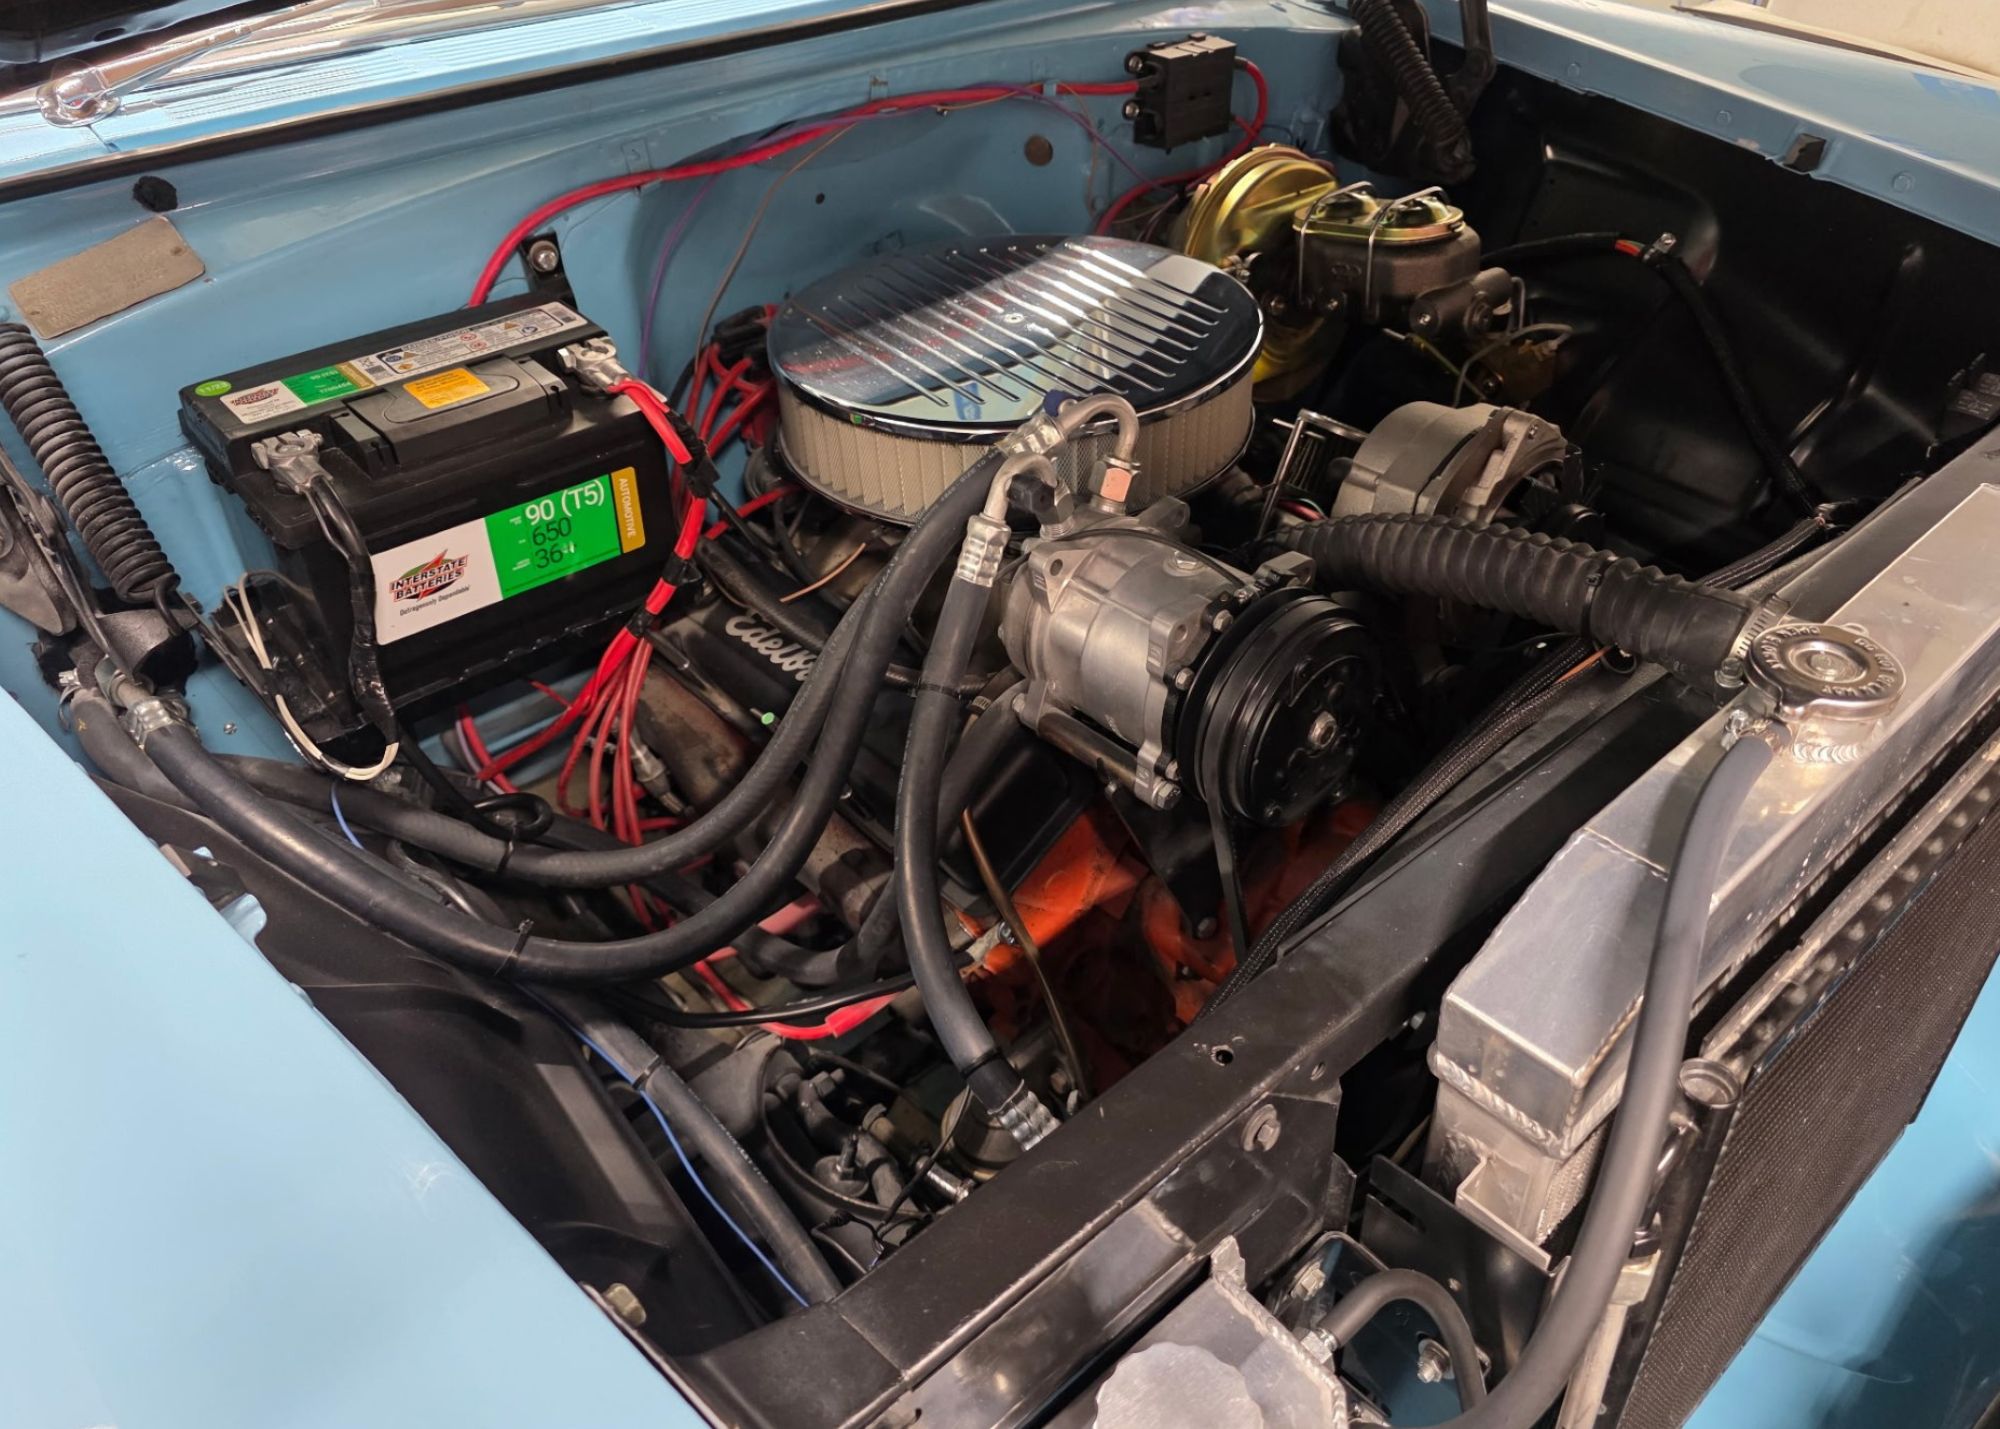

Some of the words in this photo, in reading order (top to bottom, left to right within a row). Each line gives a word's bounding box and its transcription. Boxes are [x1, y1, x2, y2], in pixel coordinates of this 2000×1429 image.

[525, 499, 555, 526] 90
[561, 479, 605, 517] (T5)
[618, 477, 636, 539] AUTOMOTIVE
[532, 517, 572, 547] 650
[390, 555, 467, 592] INTERSTATE
[395, 567, 464, 600] BATTERIES
